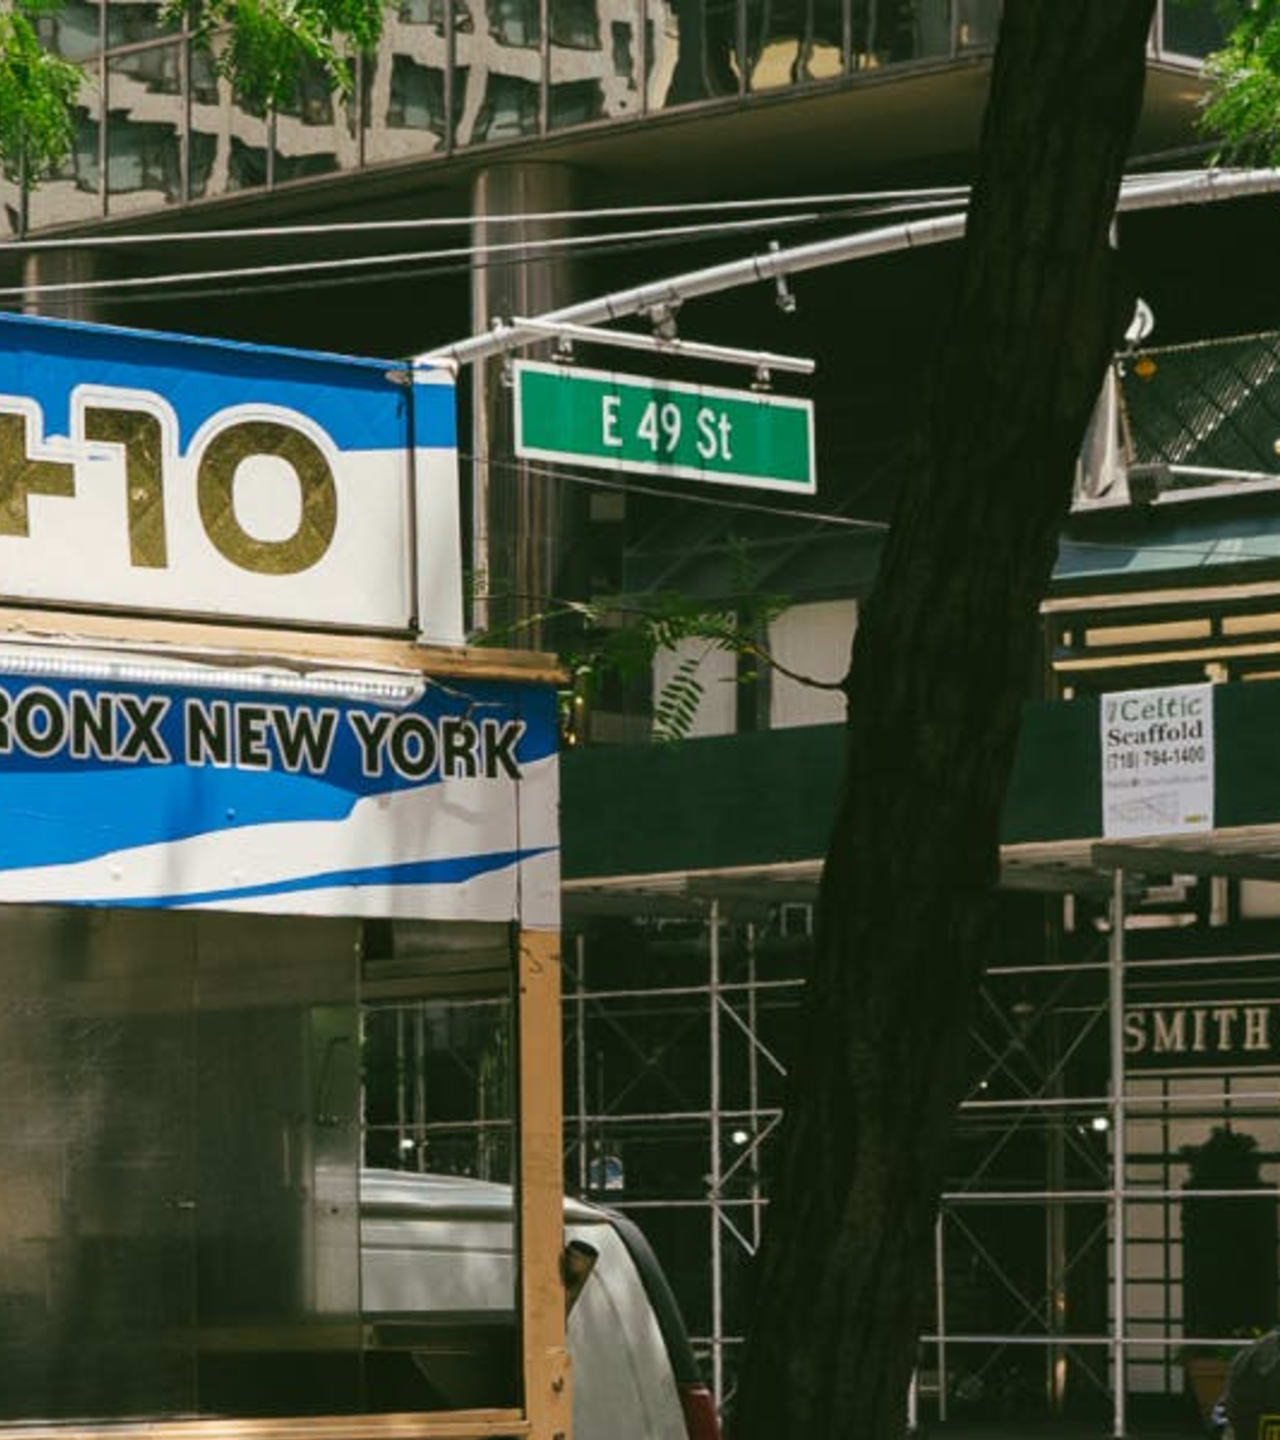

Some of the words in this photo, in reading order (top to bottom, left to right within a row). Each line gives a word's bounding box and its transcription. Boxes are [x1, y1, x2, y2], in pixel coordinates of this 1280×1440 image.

[602, 395, 623, 447] E
[638, 400, 682, 453] 49
[697, 406, 733, 462] St
[1120, 696, 1203, 722] Celtic
[186, 703, 339, 780] NEW
[348, 711, 523, 782] YORK
[1107, 720, 1204, 747] Scaffold
[1123, 1006, 1271, 1053] SMITH
